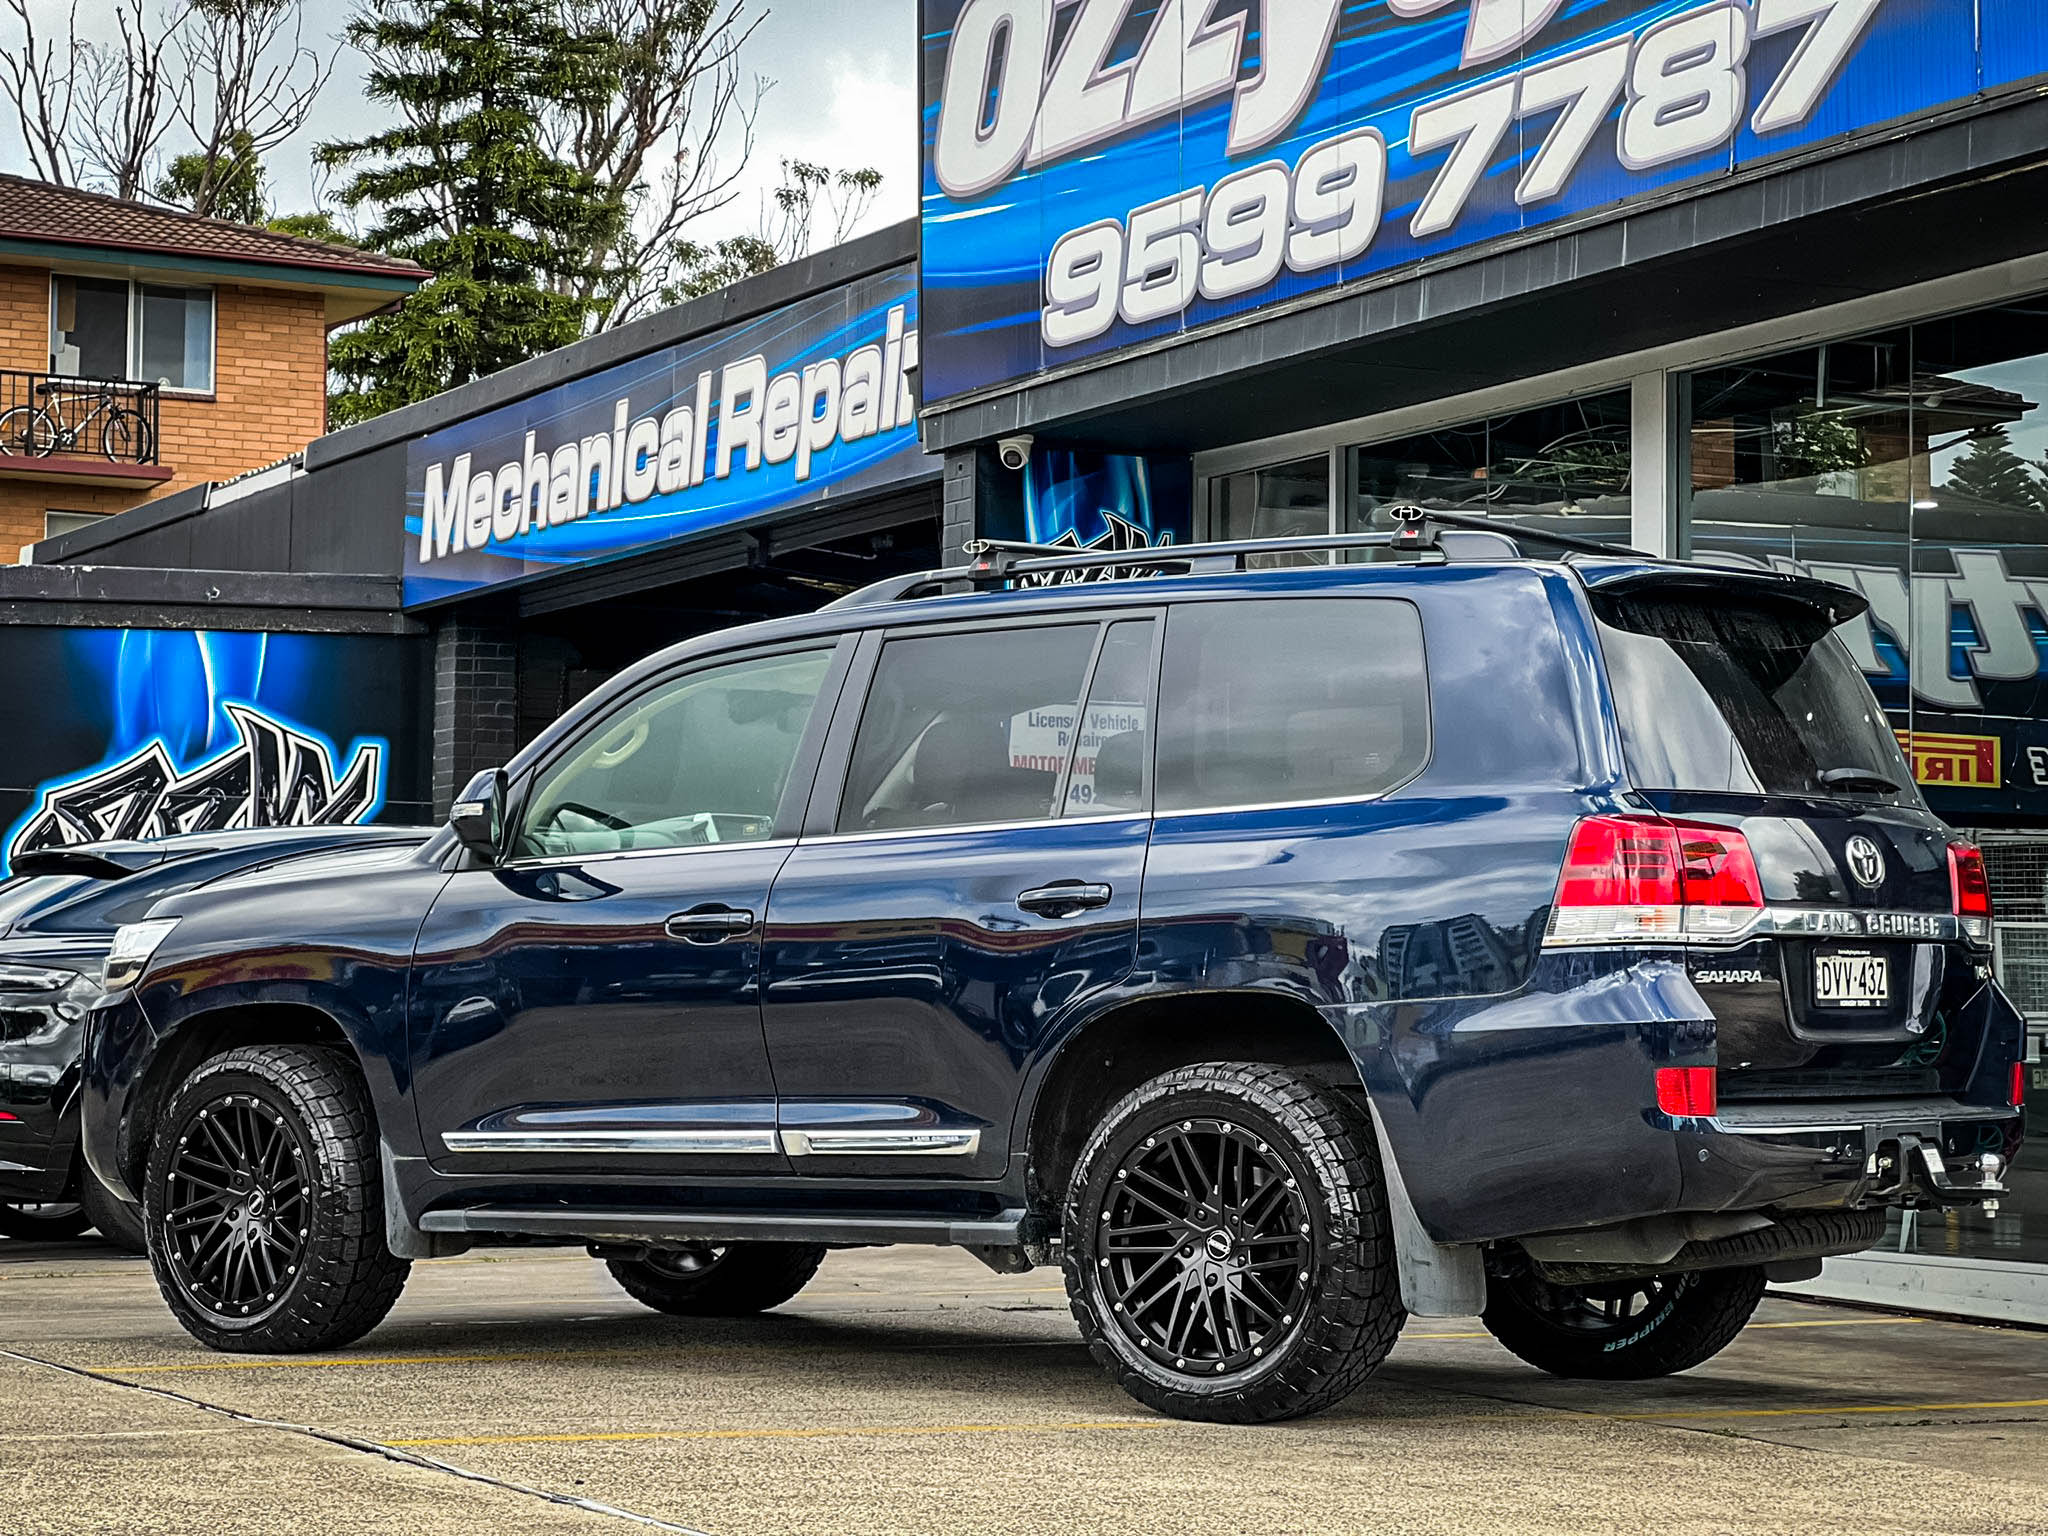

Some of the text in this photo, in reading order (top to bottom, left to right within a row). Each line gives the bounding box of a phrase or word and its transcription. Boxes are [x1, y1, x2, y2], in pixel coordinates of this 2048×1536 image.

[1041, 0, 1884, 347] 9599 7787
[419, 369, 713, 564] Mechanical
[1090, 713, 1139, 731] Vehicle
[1694, 969, 1763, 984] SAHARA
